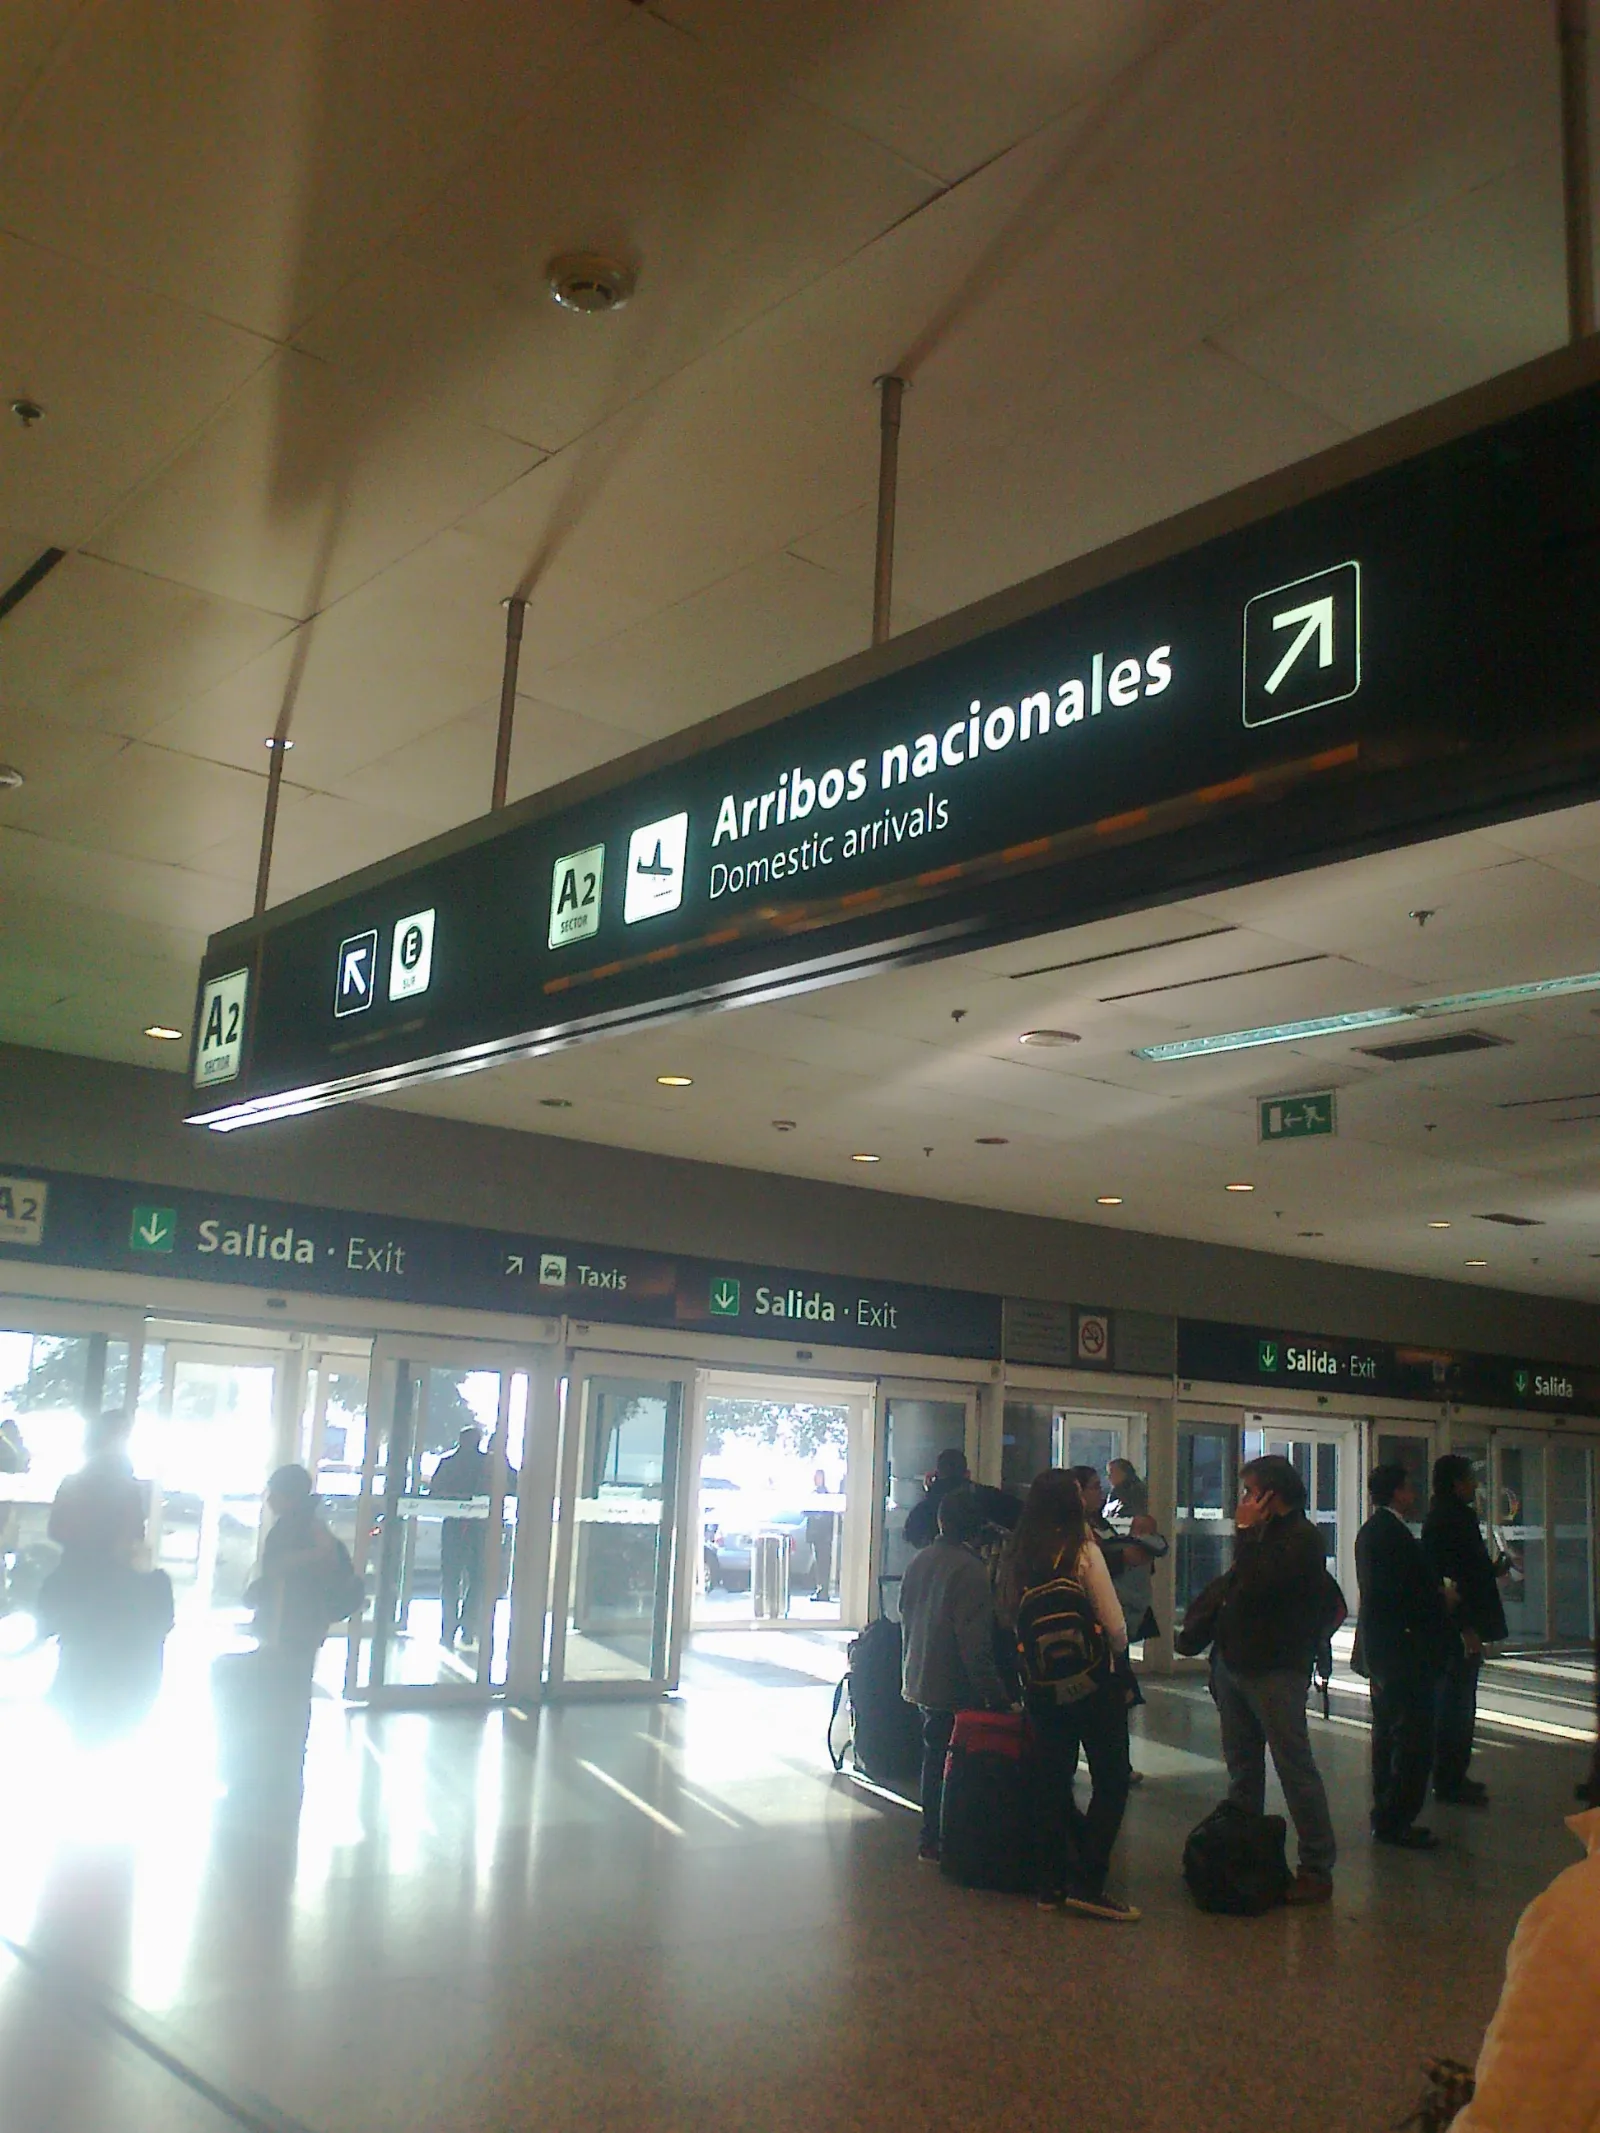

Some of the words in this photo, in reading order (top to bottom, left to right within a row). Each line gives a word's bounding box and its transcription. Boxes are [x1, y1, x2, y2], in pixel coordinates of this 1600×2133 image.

[711, 754, 867, 848] Arribos
[880, 643, 1173, 790] nacionales
[709, 832, 834, 900] Domestic
[842, 792, 950, 860] arrivals
[556, 868, 596, 915] A2
[202, 995, 240, 1051] A2
[197, 1219, 315, 1264] Salida
[346, 1236, 406, 1275] Exit
[578, 1264, 628, 1291] Taxis
[754, 1287, 836, 1323] Salida
[856, 1299, 898, 1330] Exit
[1286, 1348, 1338, 1375] Salida
[1350, 1354, 1377, 1380] Exit
[1534, 1375, 1574, 1398] Salida
